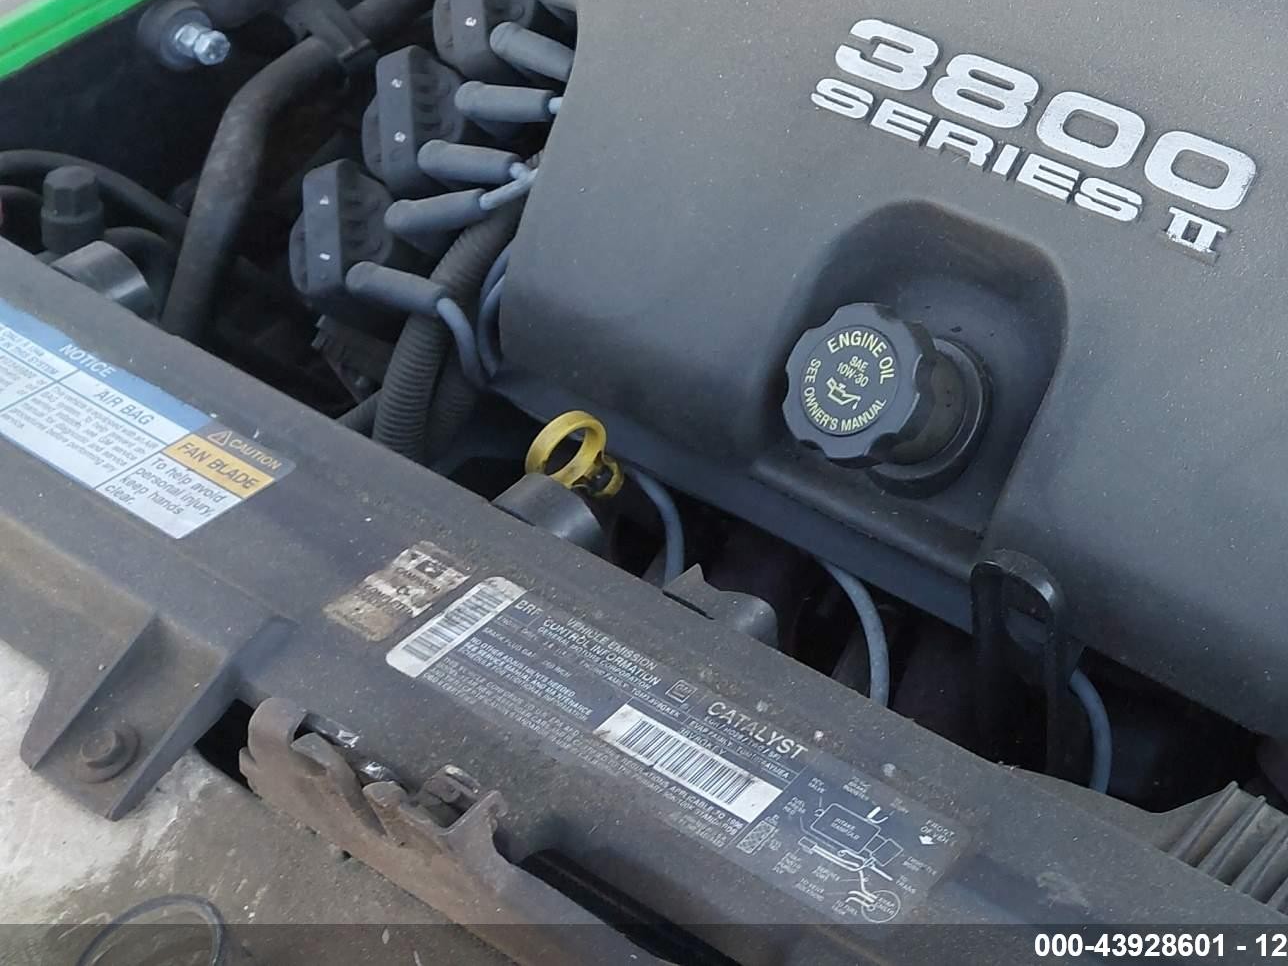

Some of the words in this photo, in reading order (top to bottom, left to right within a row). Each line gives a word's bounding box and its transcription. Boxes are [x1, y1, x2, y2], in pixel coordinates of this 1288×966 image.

[835, 19, 1256, 210] 3800
[810, 78, 1143, 223] SERIES
[57, 343, 117, 378] NOTICE
[806, 358, 821, 383] SEE
[827, 330, 887, 357] ENGINE
[879, 356, 895, 384] OIL
[849, 356, 868, 373] SAE
[91, 388, 125, 408] AIR
[117, 403, 156, 426] BAG
[804, 386, 838, 431] OWNER'S
[841, 398, 887, 432] MANUAL
[175, 441, 212, 462] FAN
[204, 458, 261, 489] BLADE
[226, 438, 283, 470] CAUTION
[102, 482, 140, 505] clear.
[115, 475, 151, 496] keep
[145, 490, 188, 515] hands
[132, 465, 186, 497] personal
[174, 491, 220, 517] injury,
[148, 457, 171, 470] To
[162, 466, 197, 485] help
[189, 481, 228, 503] avoid
[478, 642, 503, 657] OTHER
[535, 626, 571, 646] GENERAL
[596, 659, 653, 691] CORPORATION
[540, 618, 594, 649] CONTROL
[586, 643, 663, 687] INFORMATION
[563, 617, 612, 646] VEHICLE
[604, 639, 659, 671] EMISSION
[702, 699, 811, 761] CATALYST
